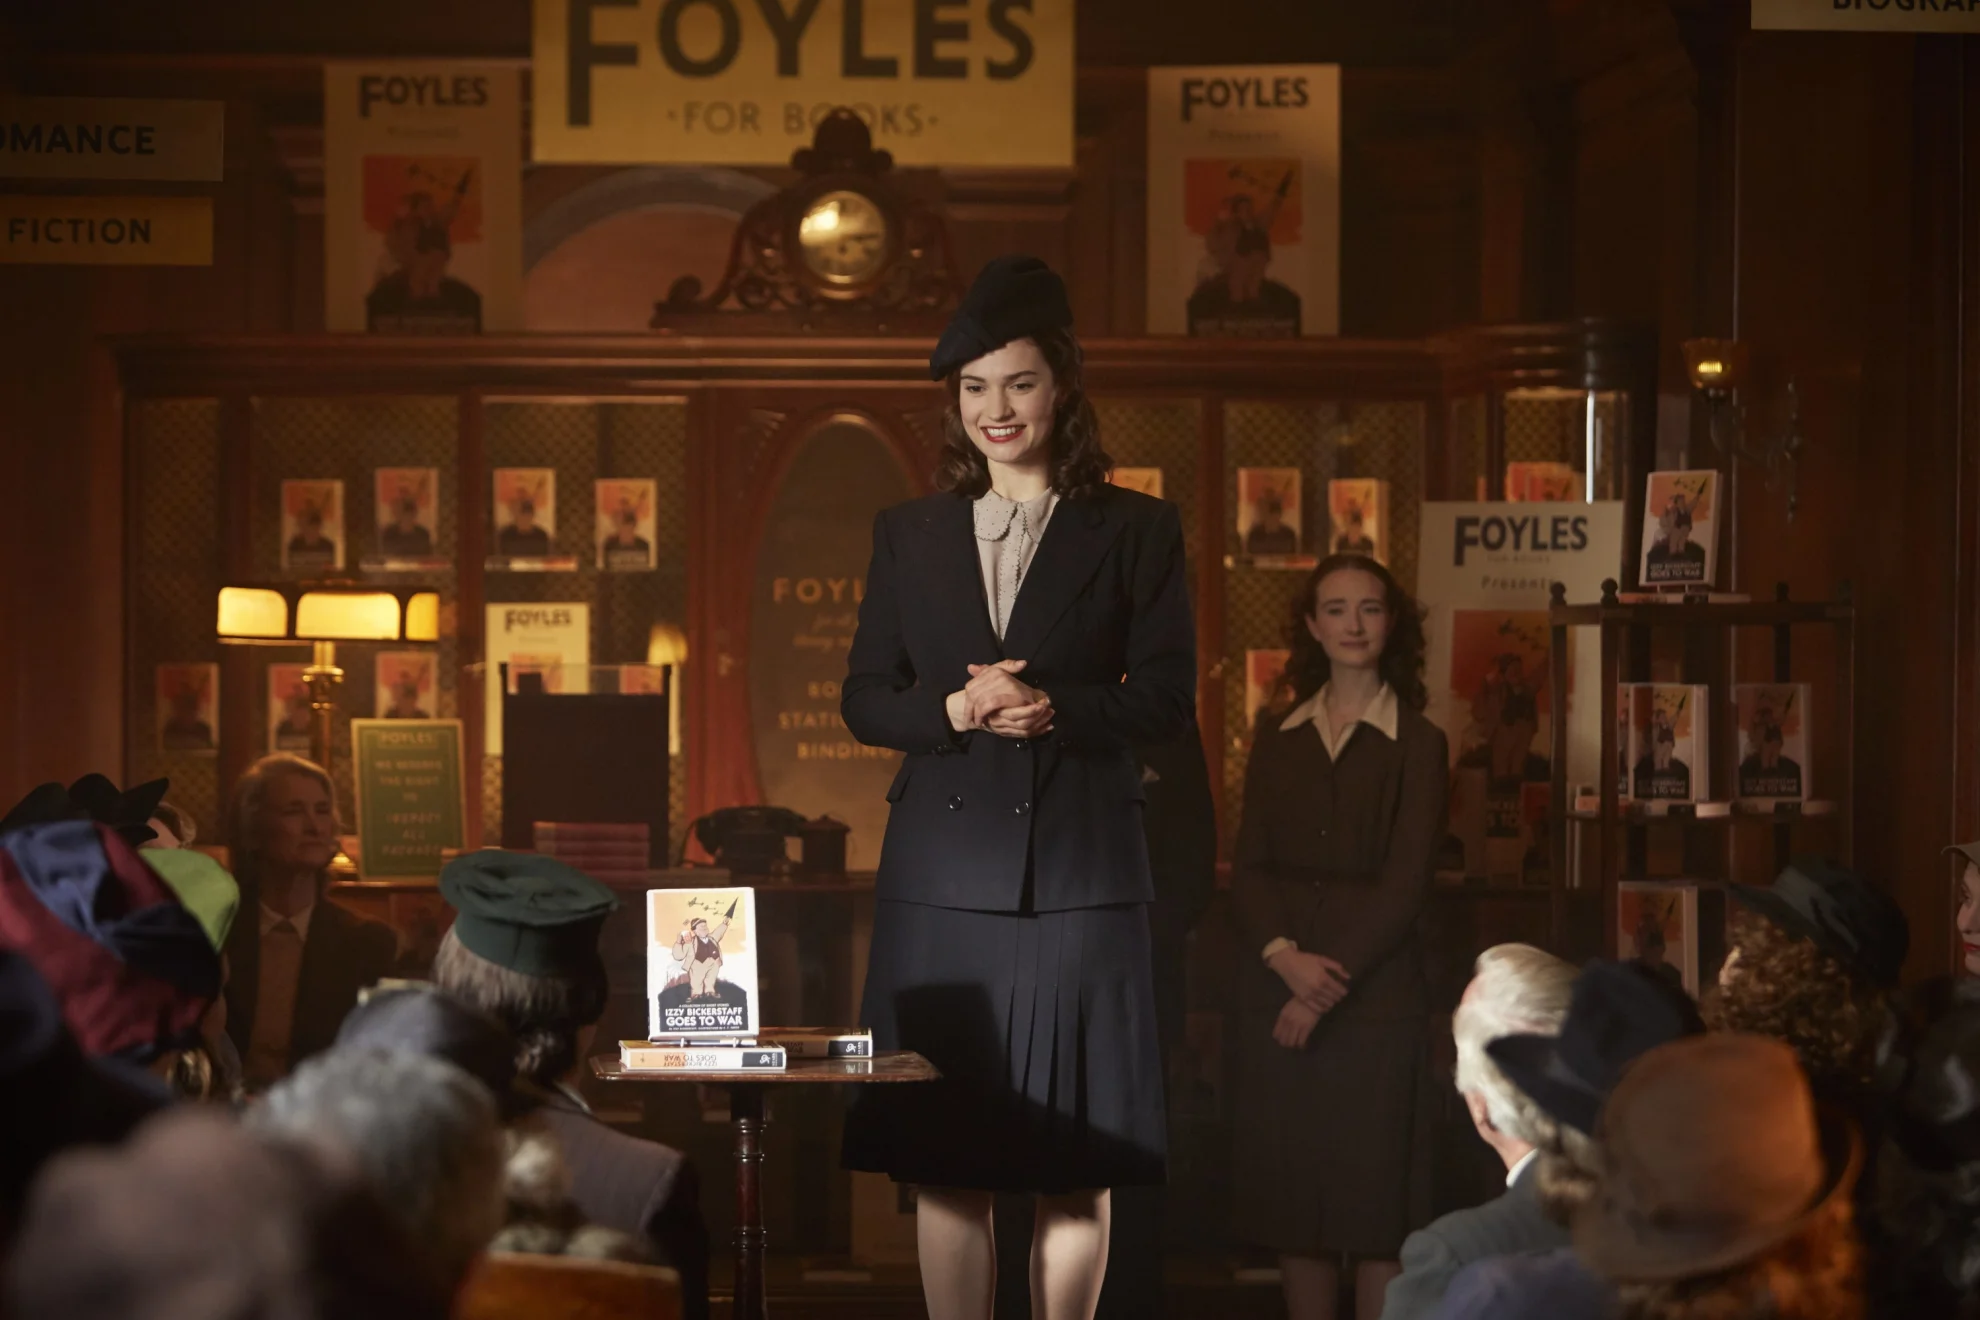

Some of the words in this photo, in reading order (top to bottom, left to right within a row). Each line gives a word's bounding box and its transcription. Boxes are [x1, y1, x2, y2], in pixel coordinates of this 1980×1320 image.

[567, 0, 1034, 126] FOYLES
[359, 75, 489, 119] FOYLES
[1181, 77, 1309, 122] FOYLES
[684, 101, 761, 136] FOR
[0, 123, 155, 155] MANCE
[9, 217, 151, 244] FICTION
[1454, 516, 1588, 566] FOYLES
[773, 577, 867, 604] FOYL
[505, 609, 572, 633] FOYLES
[665, 1008, 684, 1017] IZZY
[687, 1007, 743, 1016] BICKERSTAFF
[666, 1016, 697, 1027] GOES
[699, 1016, 715, 1026] TO
[717, 1015, 743, 1026] WAR
